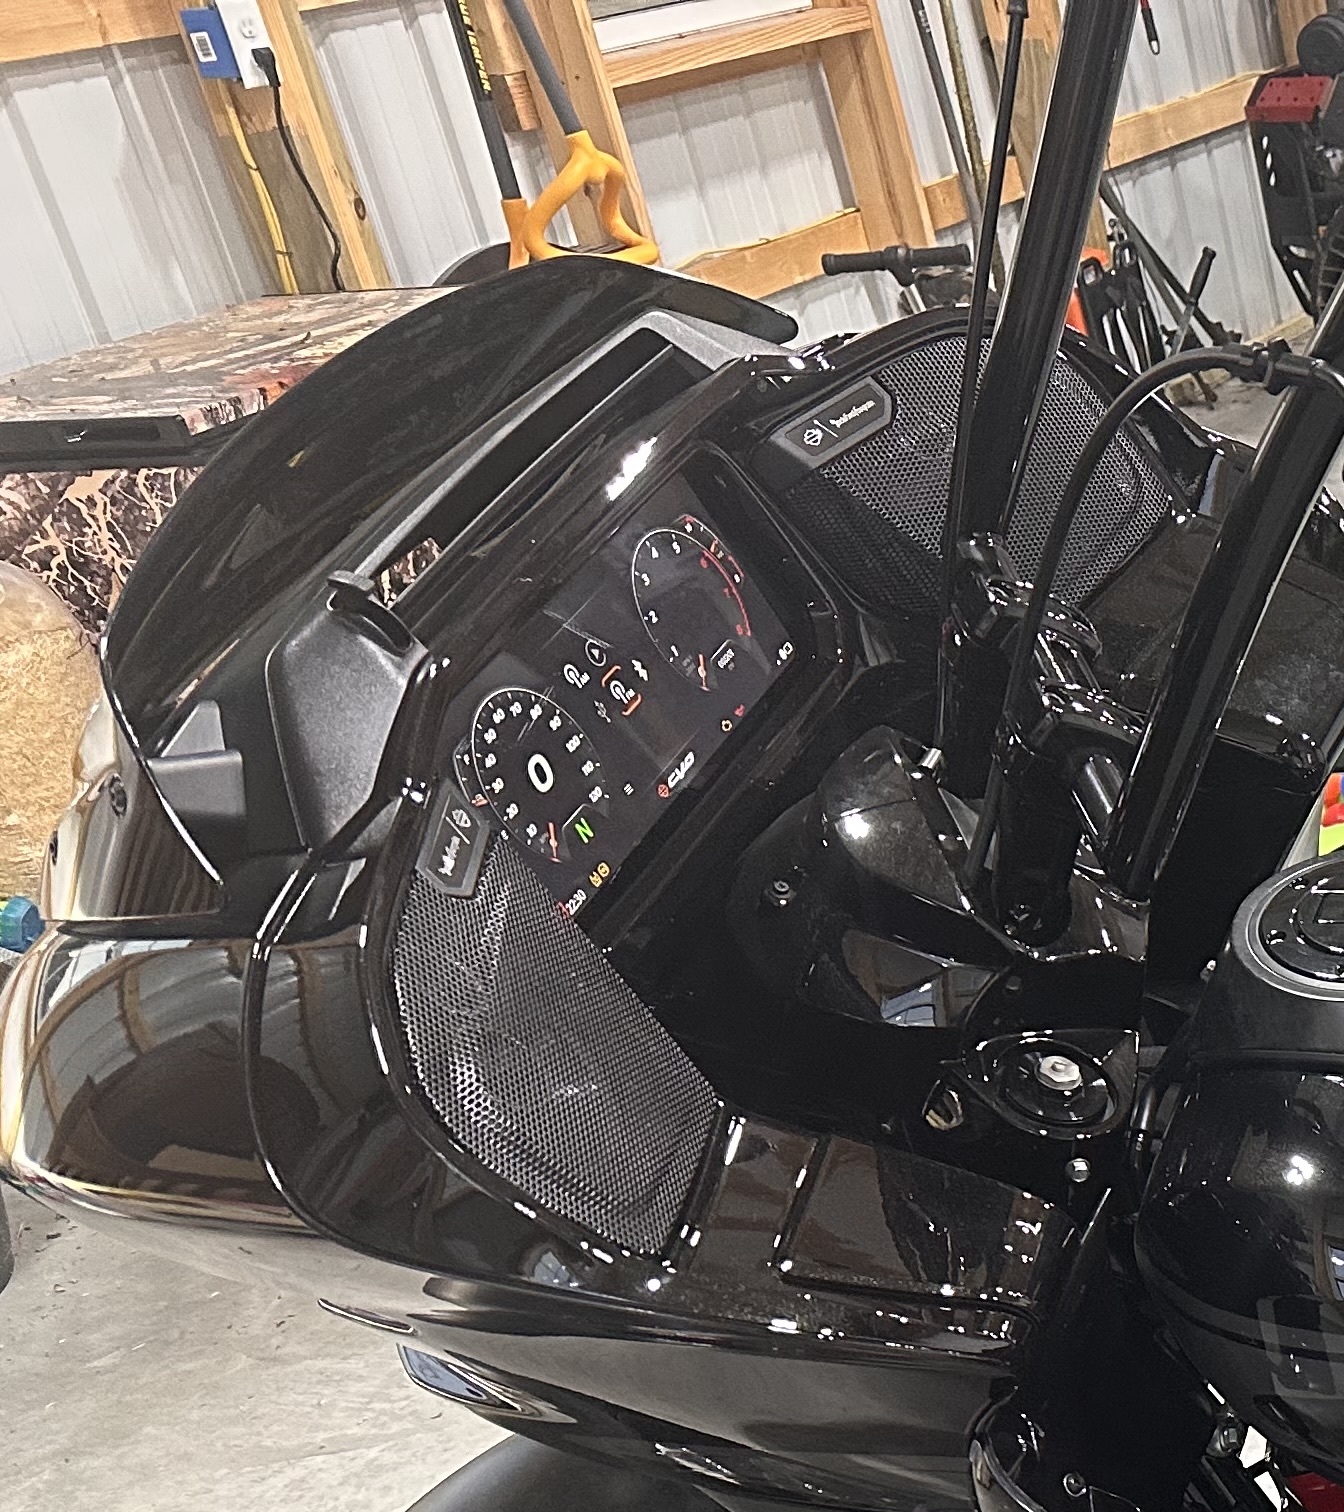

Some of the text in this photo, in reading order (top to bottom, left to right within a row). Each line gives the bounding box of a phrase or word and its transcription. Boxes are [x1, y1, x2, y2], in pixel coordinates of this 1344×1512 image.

[527, 754, 554, 793] 0
[668, 752, 694, 788] CVO
[575, 817, 594, 844] N
